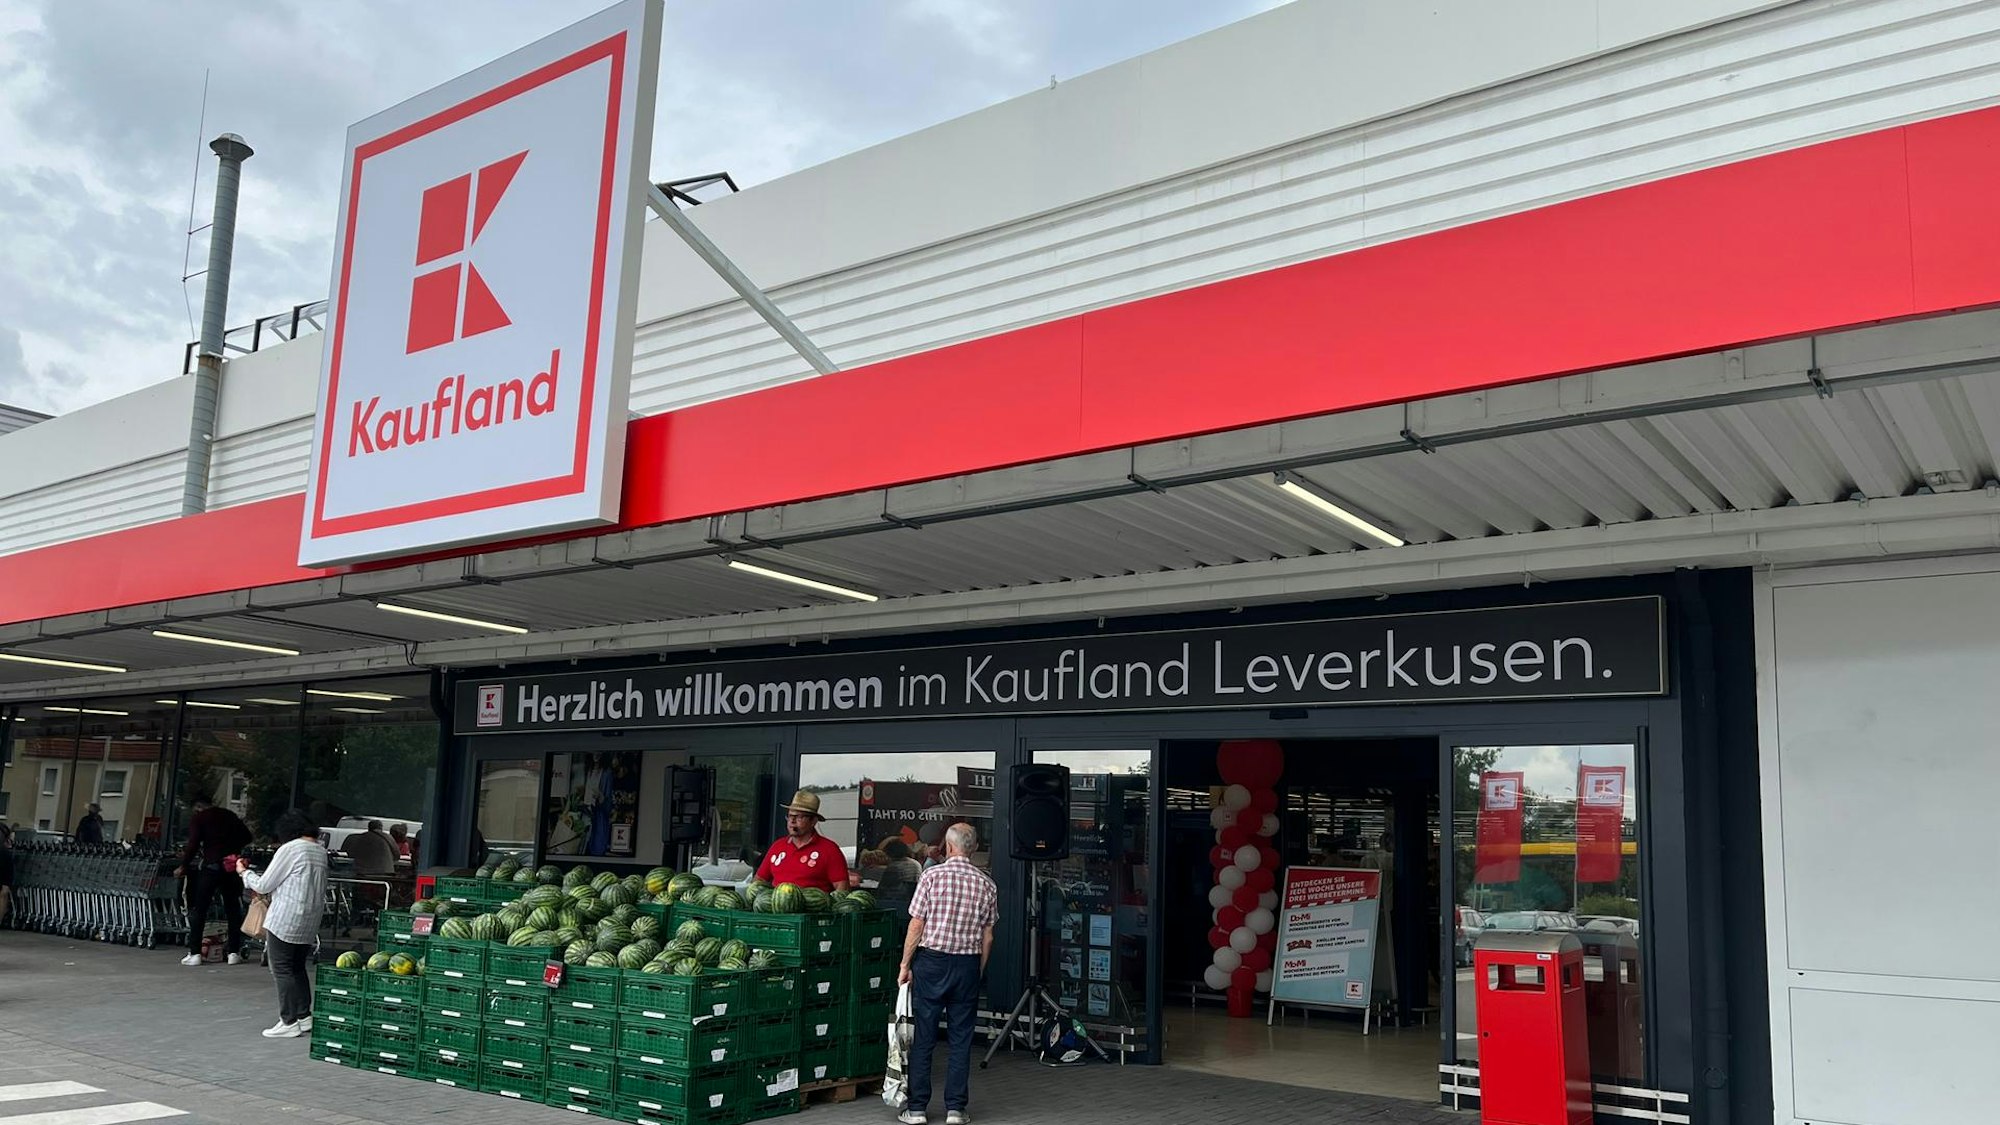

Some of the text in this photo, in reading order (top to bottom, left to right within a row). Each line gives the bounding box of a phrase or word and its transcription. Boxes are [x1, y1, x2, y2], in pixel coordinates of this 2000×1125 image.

[349, 349, 560, 457] Kaufland
[516, 629, 1614, 723] Herzlich willkommen im Kaufland Leverkusen.
[1290, 878, 1333, 888] ENTDECKEN
[1308, 885, 1334, 893] WOCHE
[1335, 881, 1365, 889] UNSERE
[1288, 894, 1307, 903] DREI
